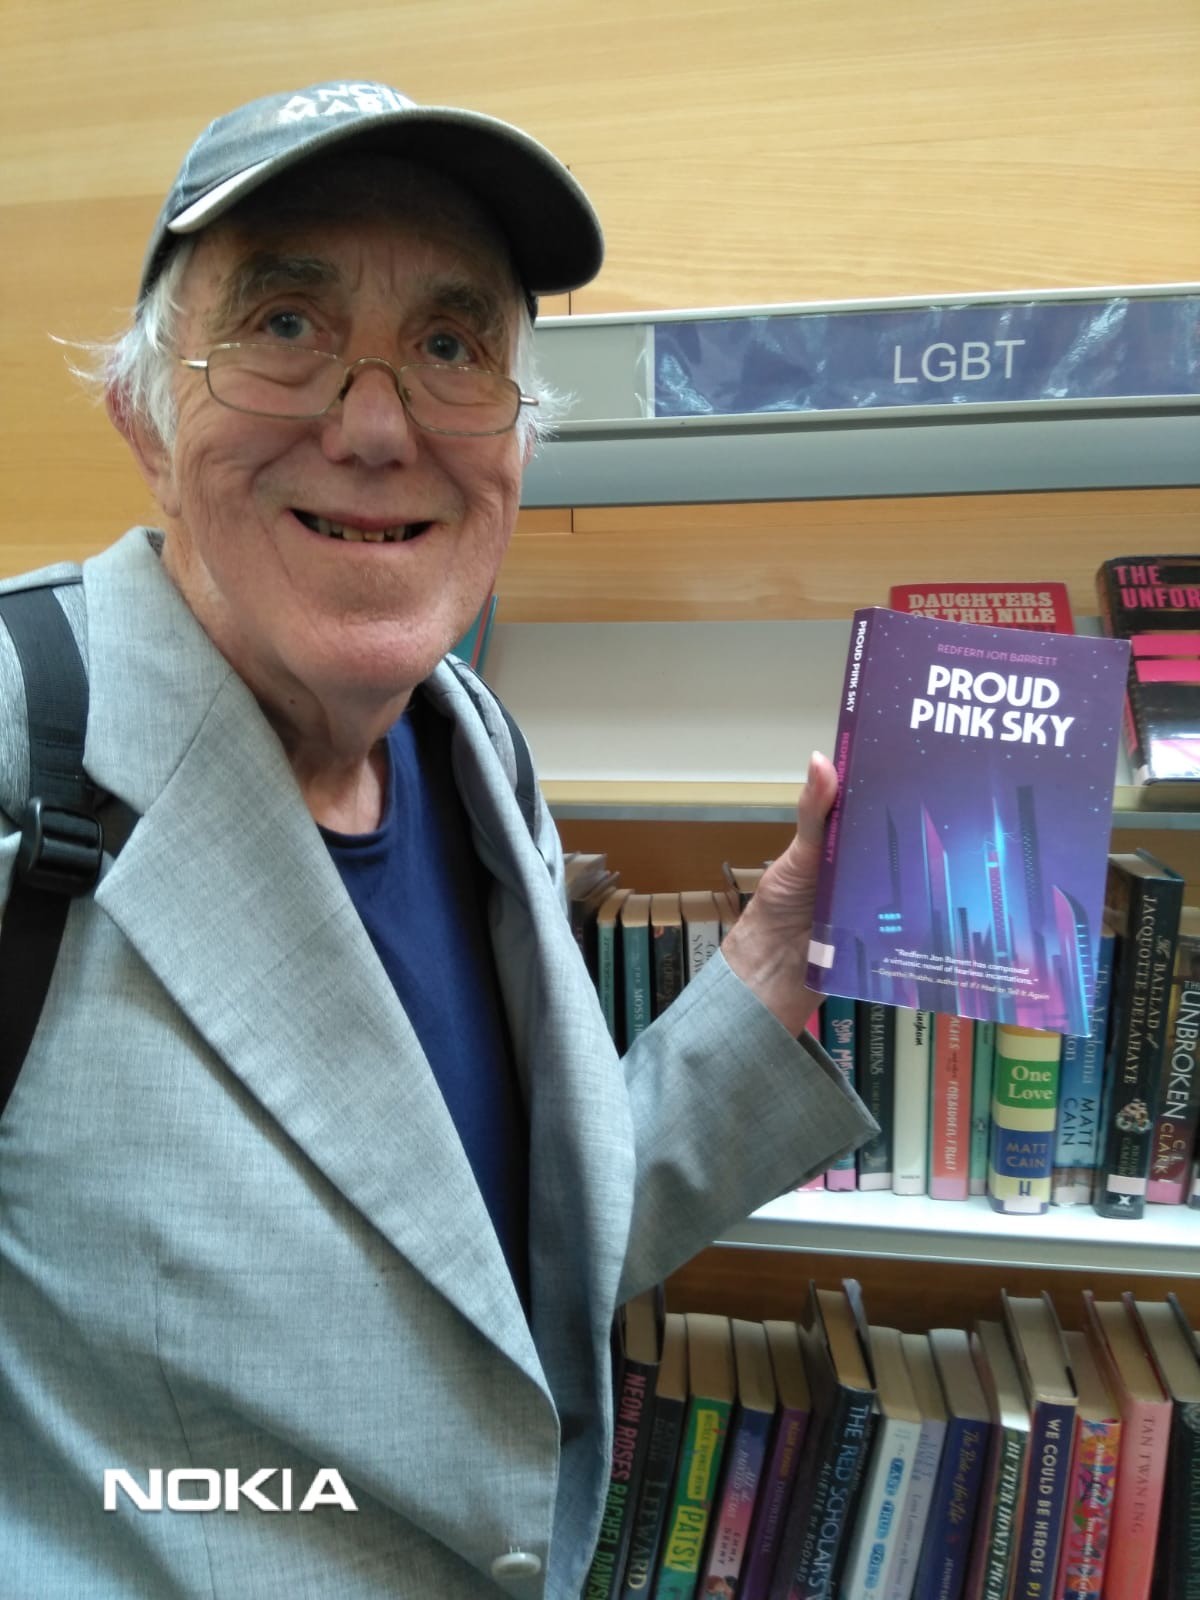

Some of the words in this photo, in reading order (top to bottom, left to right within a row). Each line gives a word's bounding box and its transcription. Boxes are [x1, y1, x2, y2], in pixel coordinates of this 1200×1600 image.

[894, 340, 1026, 384] LGBT
[1115, 565, 1161, 585] THE
[908, 592, 1053, 609] DAUGHTERS
[942, 608, 993, 624] THE
[997, 608, 1056, 623] NILE
[854, 621, 867, 661] PROUD
[938, 643, 985, 659] REDFERN
[986, 650, 1008, 661] JON
[1009, 653, 1058, 666] BARRETT
[849, 663, 861, 689] PINK
[927, 664, 1060, 709] PROUD
[846, 691, 857, 712] SKY
[910, 698, 996, 739] PINK
[1000, 710, 1075, 747] SKY
[1136, 895, 1157, 989] JACQUOTTE
[890, 958, 921, 969] virtuosic
[922, 962, 943, 972] novel
[954, 966, 984, 979] fearless
[929, 953, 944, 963] Jon
[944, 955, 972, 967] Barrett
[973, 959, 986, 969] has
[987, 962, 1029, 976] composed
[634, 988, 644, 1020] MOSS
[936, 977, 959, 987] author
[1028, 990, 1050, 1001] Again
[1147, 963, 1167, 1029] BALLAD
[869, 1022, 885, 1075] MAIDENS
[1123, 995, 1145, 1084] DELAHAYE
[1162, 990, 1200, 1119] UNBROKEN
[1008, 1084, 1053, 1100] Love
[1012, 1065, 1052, 1082] One
[946, 1080, 959, 1138] FORBIDDEN
[1062, 1098, 1077, 1146] CAIN
[1079, 1098, 1096, 1147] MATT
[944, 1140, 957, 1171] FRUIT
[1006, 1143, 1048, 1154] MATT
[1006, 1156, 1046, 1168] CAIN
[1154, 1122, 1175, 1174] CLARK
[618, 1372, 647, 1423] NEON
[844, 1404, 870, 1438] THE
[1045, 1418, 1062, 1440] WE
[1141, 1416, 1155, 1446] TAN
[611, 1424, 639, 1481] ROSES
[835, 1444, 859, 1481] RED
[999, 1440, 1021, 1504] BUTTER
[1039, 1445, 1058, 1495] COULD
[812, 1461, 833, 1511] ALIETTE
[1136, 1454, 1151, 1498] TWAN
[600, 1482, 628, 1546] RACHEL
[1037, 1500, 1050, 1516] BE
[1131, 1502, 1145, 1534] ENG
[627, 1479, 668, 1591] LEEWARD
[671, 1506, 707, 1572] PATSY
[718, 1527, 731, 1565] DENNY
[728, 1532, 741, 1563] EMMA
[809, 1485, 850, 1588] SCHOLAR'S
[993, 1505, 1013, 1556] HONEY
[1030, 1521, 1049, 1574] HEROES
[797, 1530, 816, 1583] BODARD
[988, 1560, 1005, 1589] PIG
[1027, 1582, 1041, 1598] PJ
